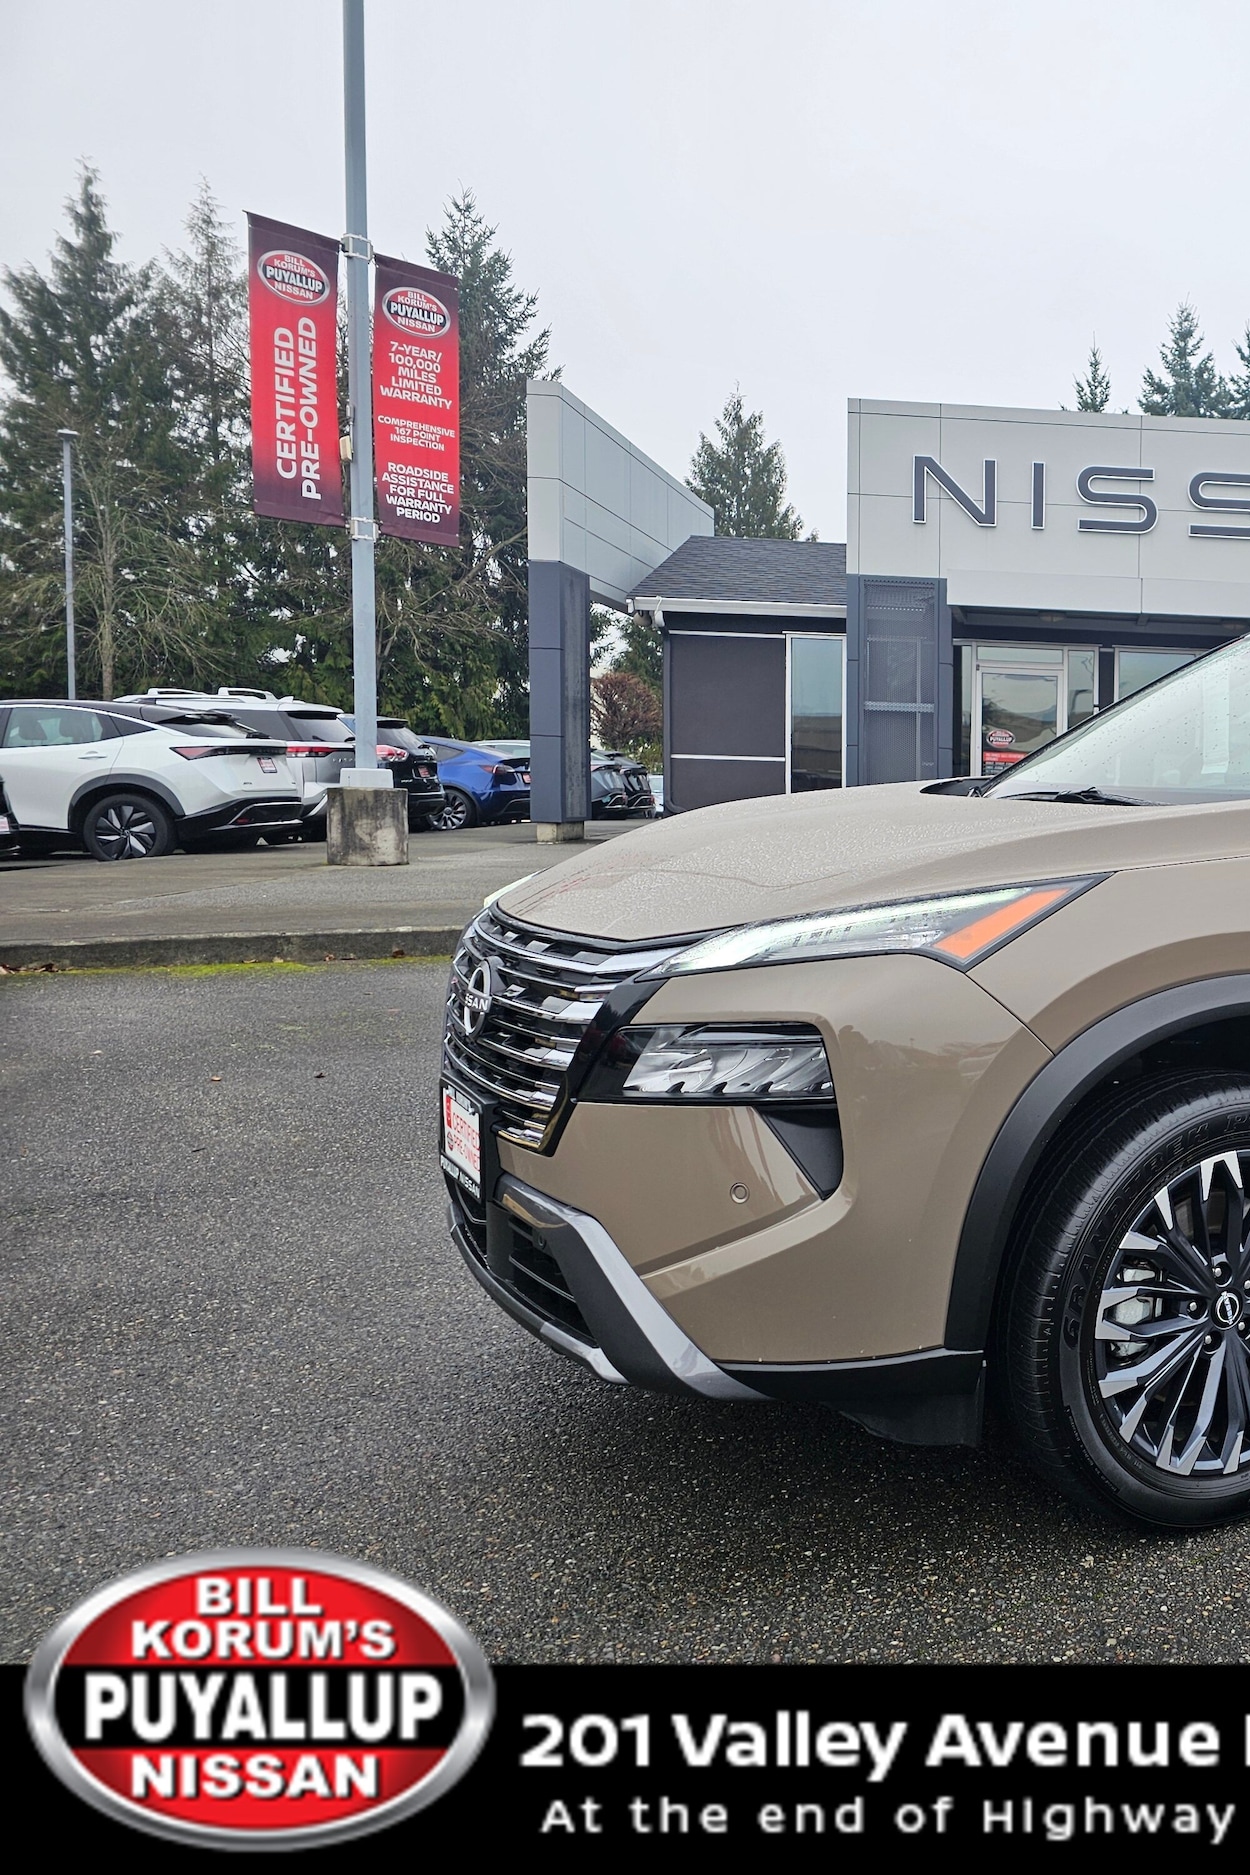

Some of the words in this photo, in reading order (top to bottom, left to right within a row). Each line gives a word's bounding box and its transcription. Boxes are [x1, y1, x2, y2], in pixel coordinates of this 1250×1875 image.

[274, 258, 316, 278] KORUM'S
[284, 254, 305, 267] BILL
[266, 265, 323, 293] PUYALLUP
[274, 281, 314, 300] NISSAN
[407, 291, 427, 303] BILL
[390, 301, 444, 326] PUYALLUP
[397, 295, 437, 312] KORUM'S
[397, 316, 435, 333] NISSAN
[390, 341, 442, 363] 7-YEAR/
[388, 353, 441, 374] 100,000
[398, 366, 437, 384] MILES
[391, 376, 442, 396] LIMITED
[274, 326, 297, 480] CERTIFIED
[380, 385, 452, 410] WARRANTY
[298, 316, 322, 501] PRE-OWNED
[377, 415, 456, 438] COMPREHENSIVE
[394, 426, 412, 436] 167
[412, 430, 441, 442] POINT
[390, 433, 445, 451] INSPECTION
[387, 461, 449, 483] ROADSIDE
[382, 472, 454, 494] ASSISTANCE
[385, 493, 452, 515] WARRANTY
[389, 484, 416, 498] FOR
[417, 489, 446, 504] FULL
[396, 506, 441, 523] PERIOD
[464, 993, 489, 1011] SAN
